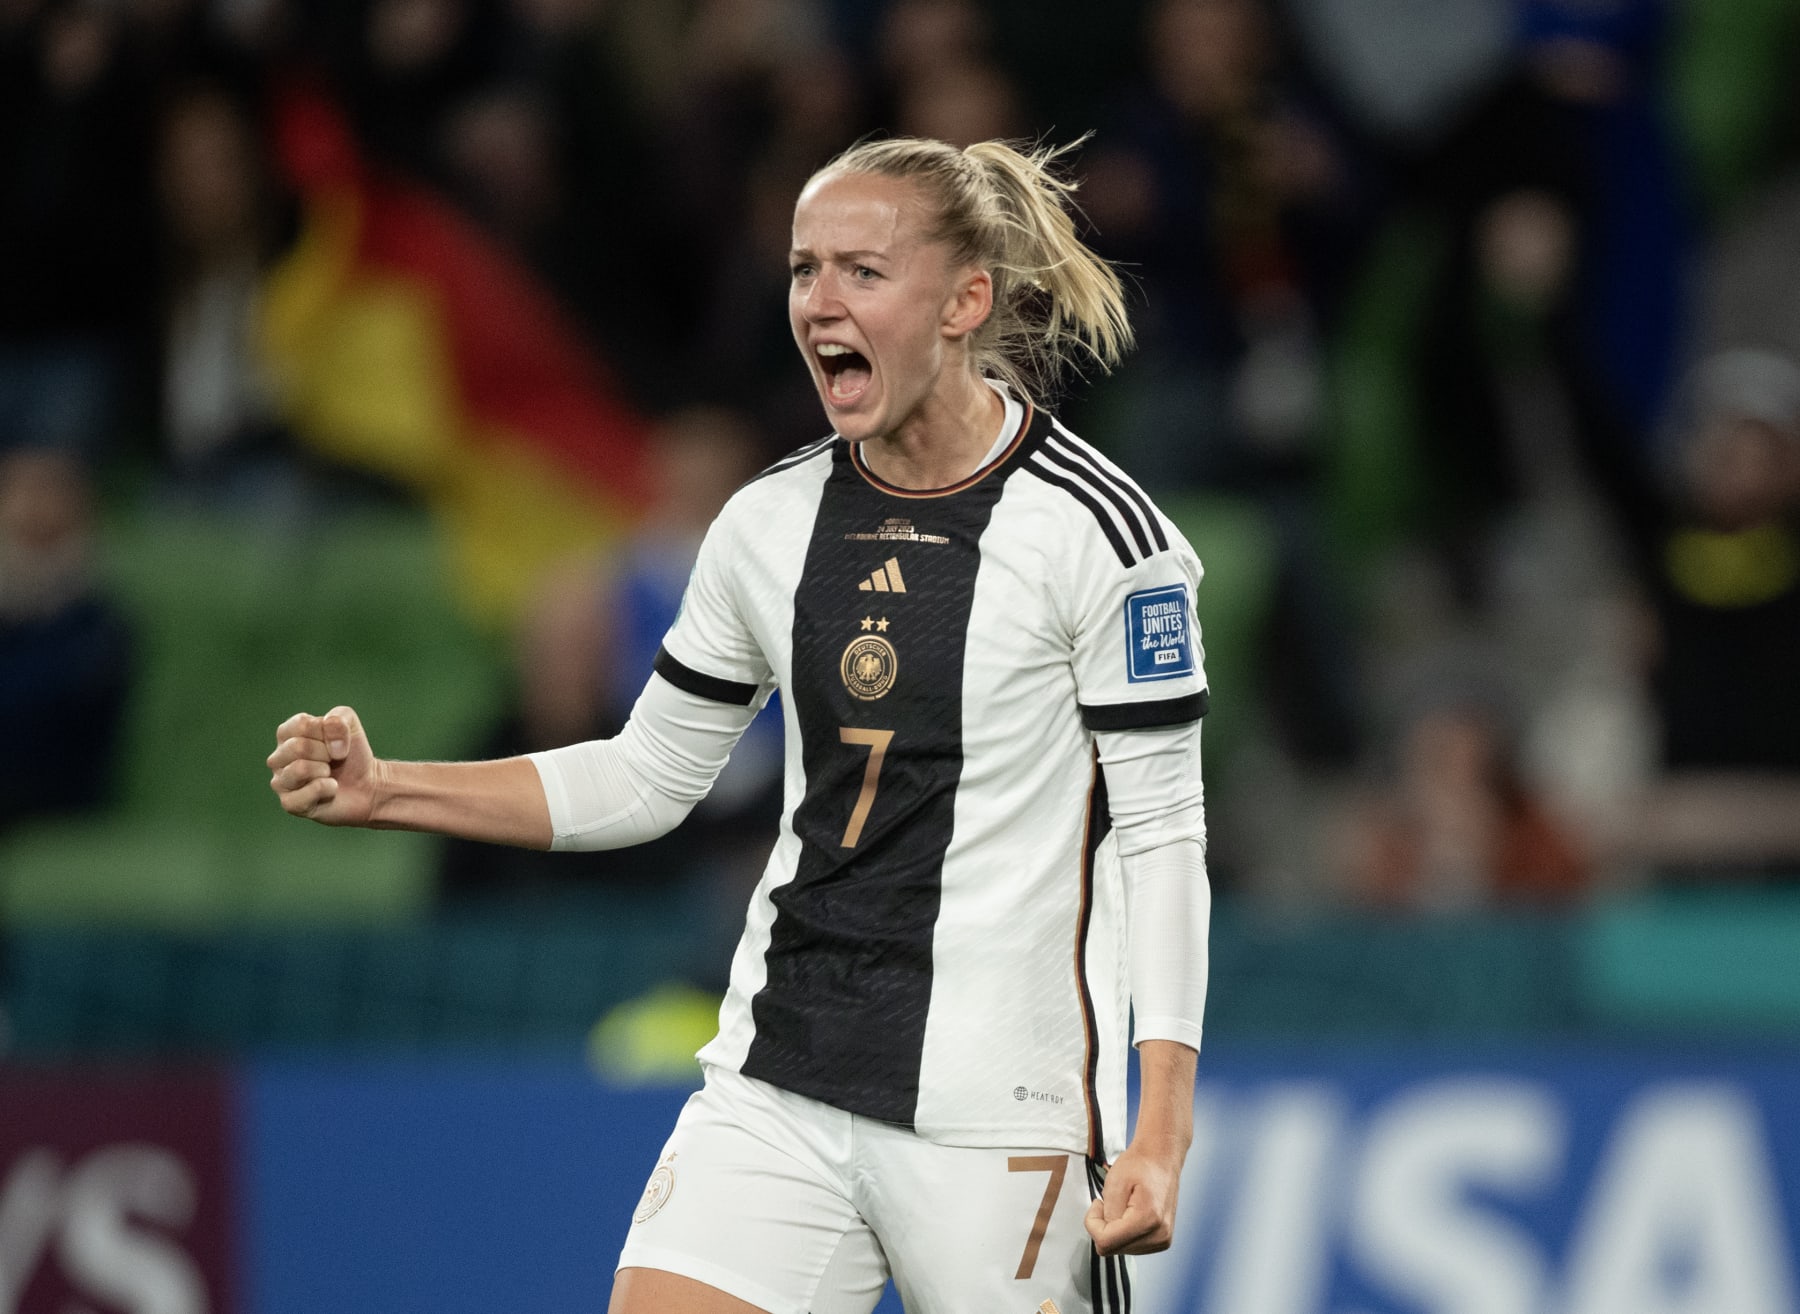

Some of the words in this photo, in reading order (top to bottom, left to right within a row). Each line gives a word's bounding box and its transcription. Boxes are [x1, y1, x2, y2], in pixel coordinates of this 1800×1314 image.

[920, 535, 949, 544] STADIUM
[1142, 601, 1181, 618] FOOTBALL
[1142, 614, 1183, 635] UNITES
[1141, 634, 1159, 650] the
[1160, 630, 1185, 647] World
[1158, 652, 1177, 661] FIFA
[839, 727, 895, 848] 7
[1008, 1155, 1069, 1280] 7
